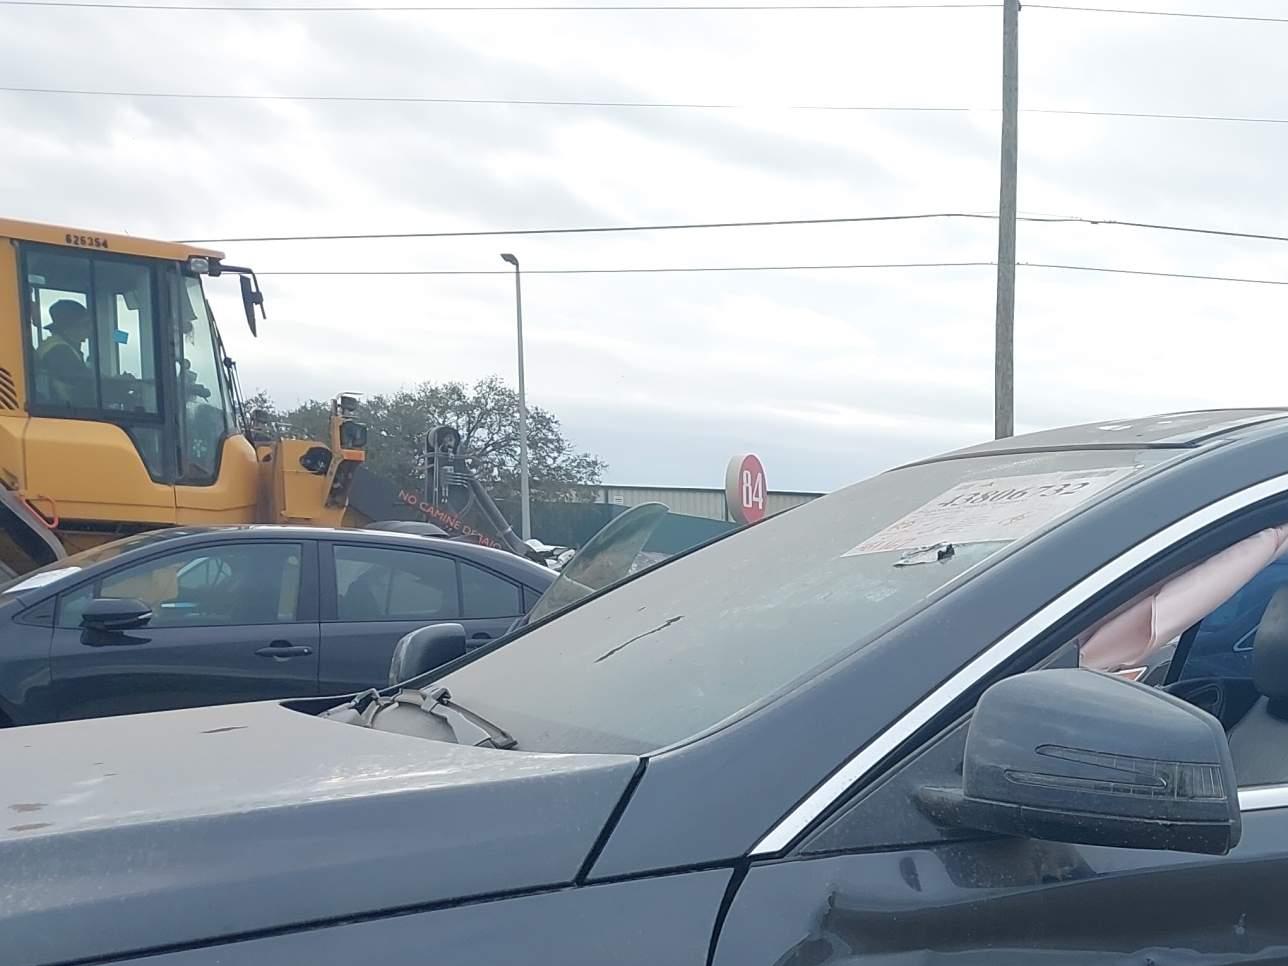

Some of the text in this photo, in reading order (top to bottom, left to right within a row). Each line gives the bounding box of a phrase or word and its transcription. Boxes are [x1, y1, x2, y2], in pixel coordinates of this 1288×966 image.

[398, 489, 417, 505] NO
[419, 501, 462, 530] CAMINE
[742, 470, 764, 510] 84
